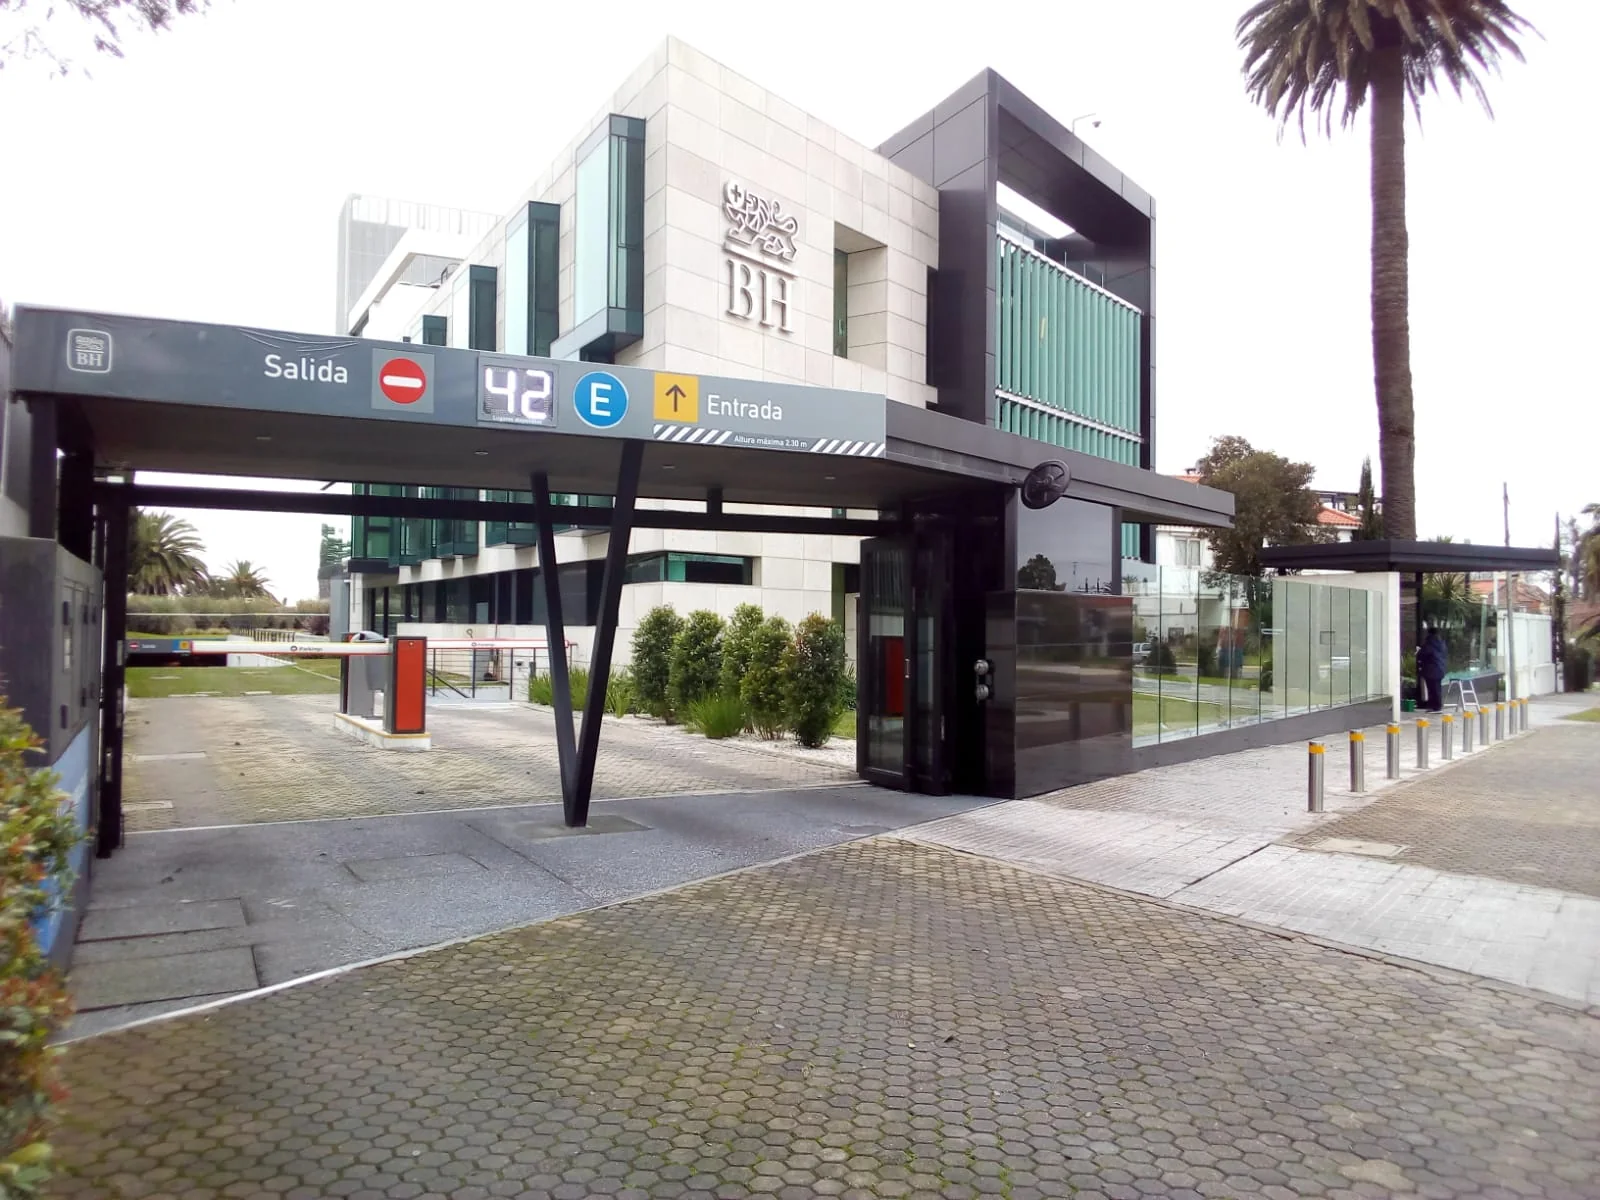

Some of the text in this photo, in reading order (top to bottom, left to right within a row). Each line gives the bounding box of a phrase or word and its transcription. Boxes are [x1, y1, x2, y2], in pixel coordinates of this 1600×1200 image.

[726, 258, 796, 333] BH
[76, 352, 102, 367] BH
[264, 354, 348, 384] Salida
[485, 367, 551, 420] 42
[590, 382, 612, 417] E
[707, 394, 782, 421] Entrada
[734, 435, 755, 444] Altura
[756, 437, 784, 446] máxima
[786, 439, 799, 447] 2.30
